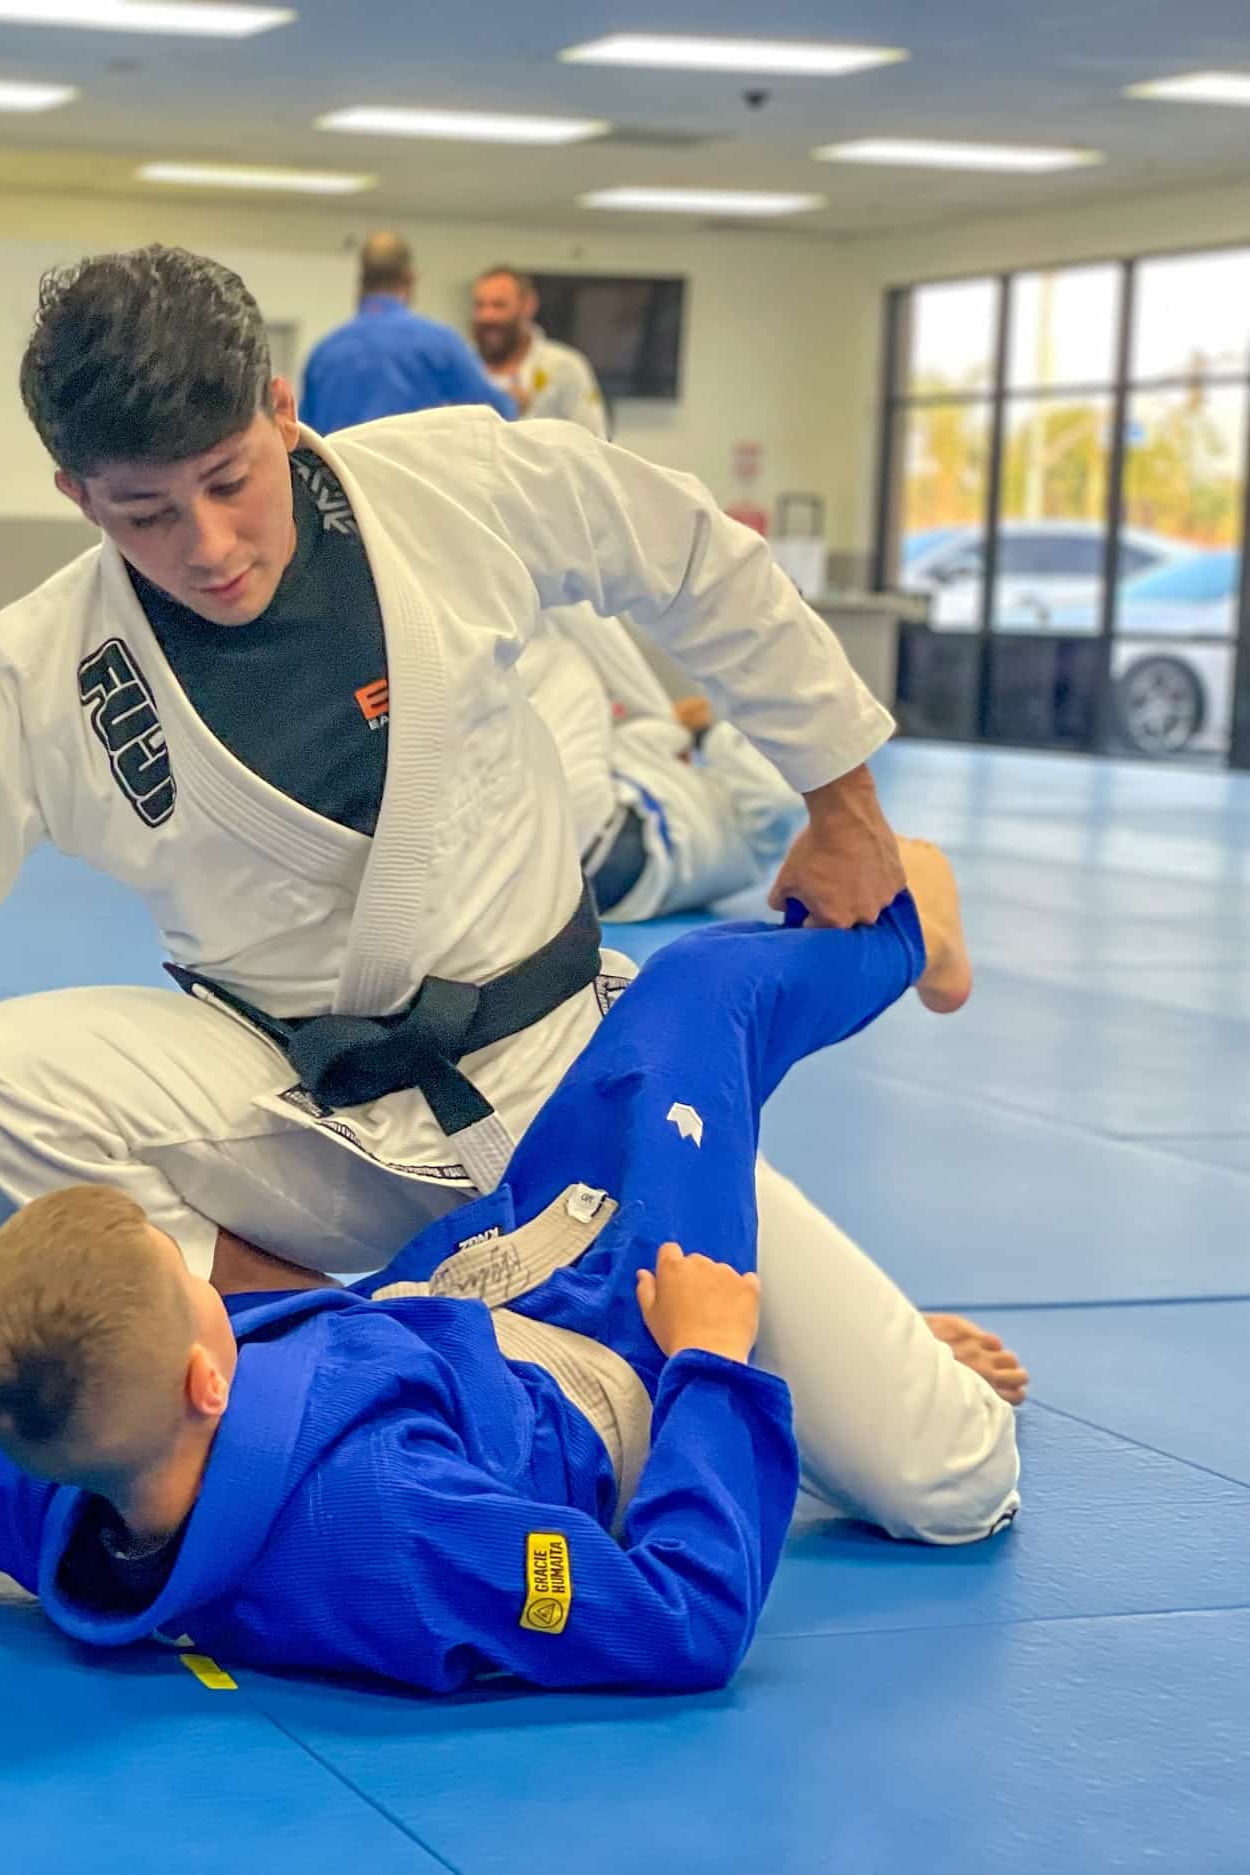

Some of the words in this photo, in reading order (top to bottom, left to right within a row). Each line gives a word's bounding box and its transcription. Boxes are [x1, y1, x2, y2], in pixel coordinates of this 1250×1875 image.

[77, 637, 176, 828] FUJI
[534, 1549, 550, 1593] GRACIE
[549, 1541, 567, 1594] HUMAITA
